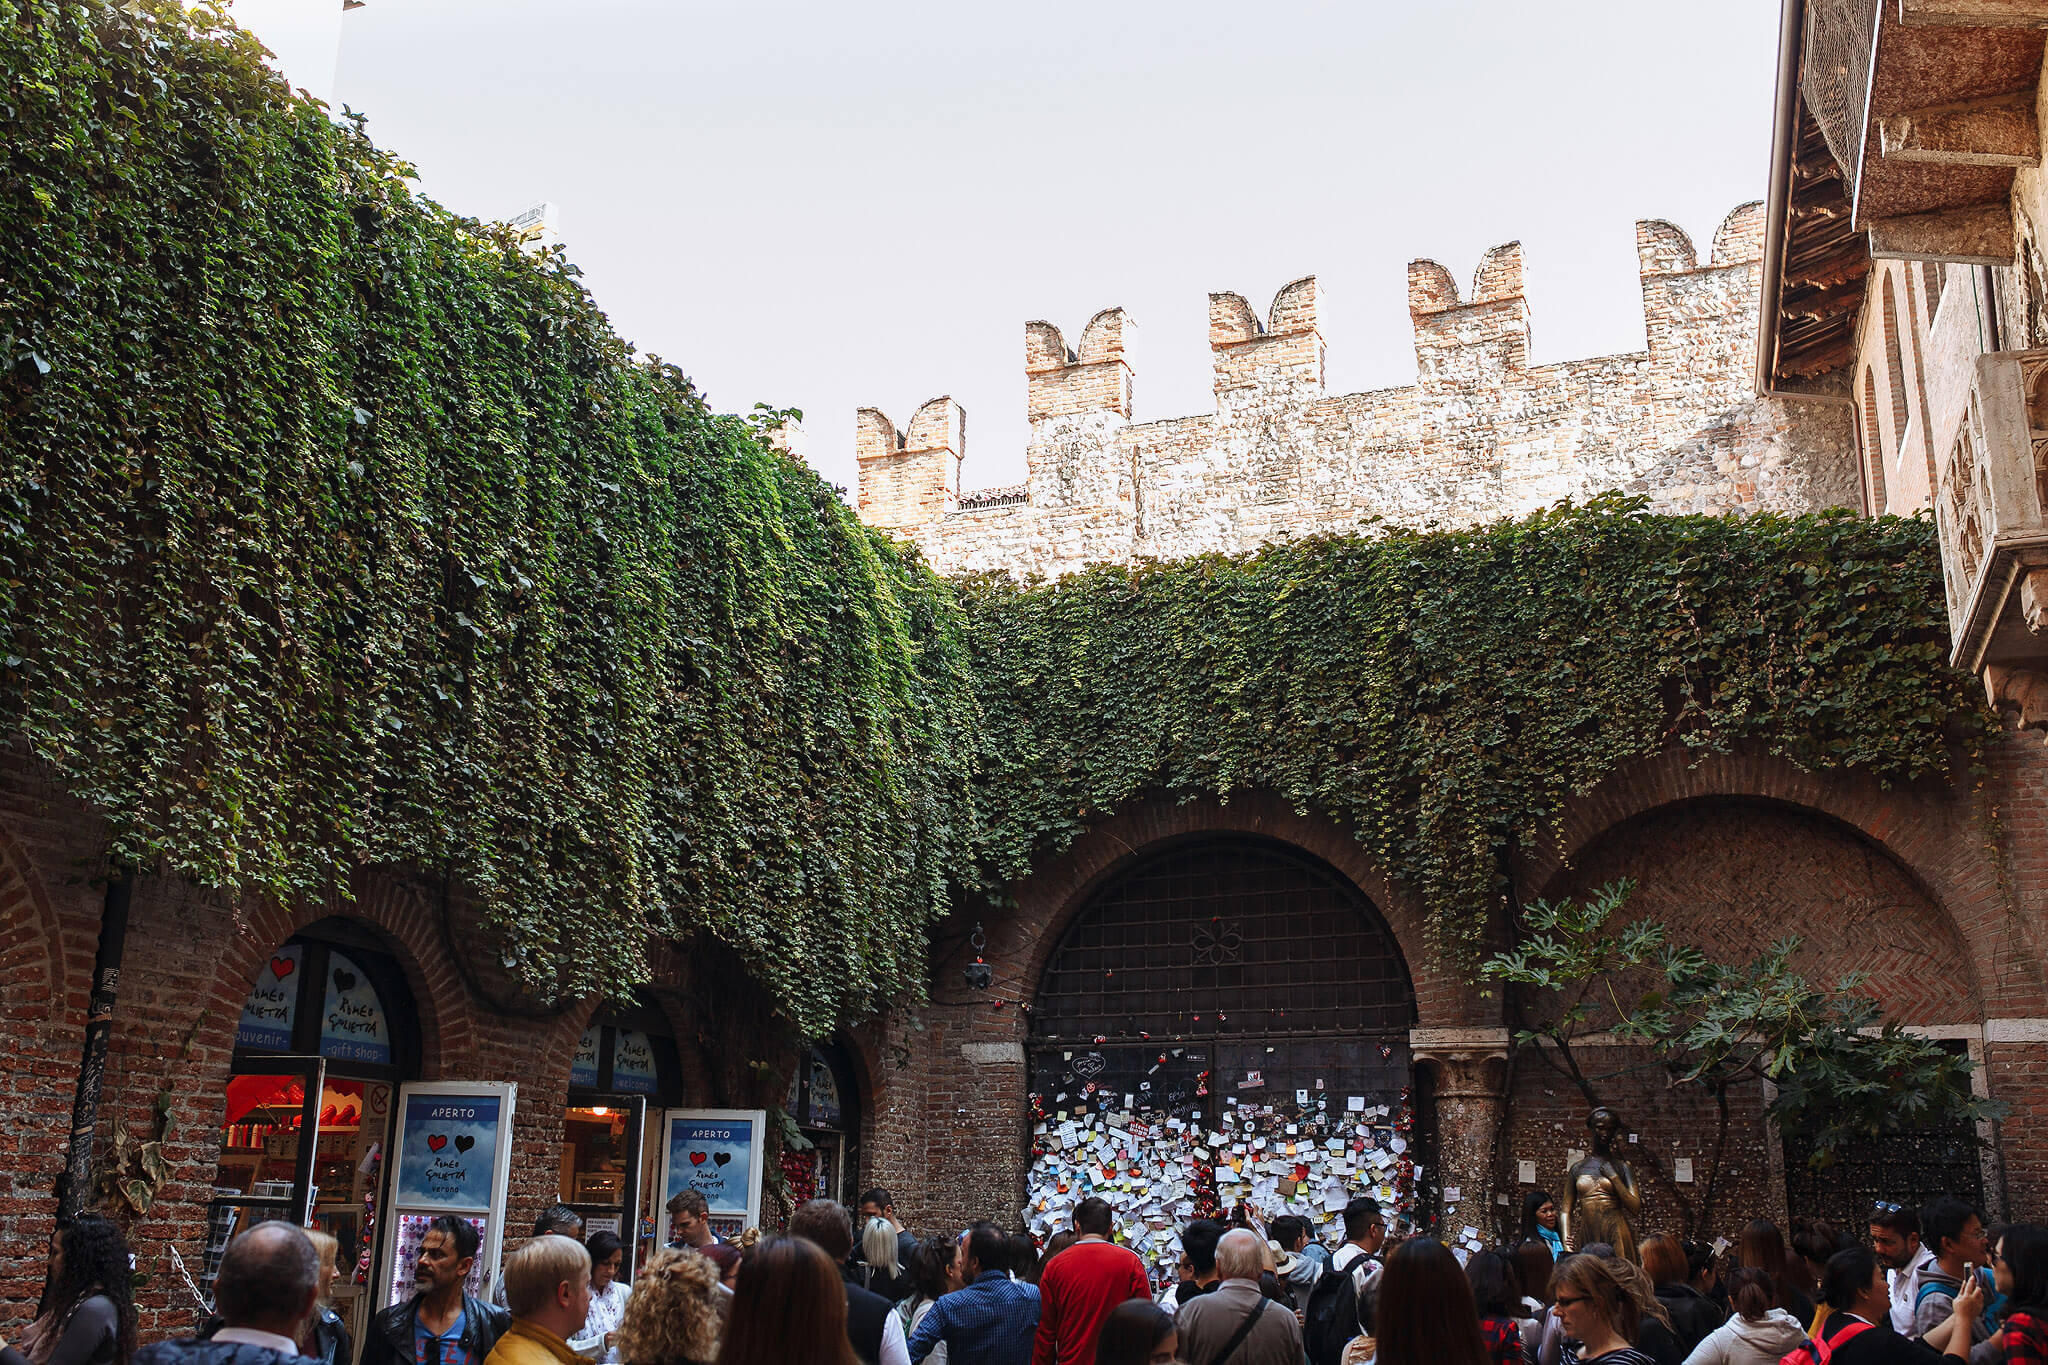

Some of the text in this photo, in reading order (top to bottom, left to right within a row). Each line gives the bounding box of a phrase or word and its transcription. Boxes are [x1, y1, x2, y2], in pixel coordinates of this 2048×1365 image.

[251, 988, 284, 1002] OMEO
[339, 997, 374, 1017] ROMEO
[236, 1031, 287, 1046] ouvenir-
[431, 1107, 475, 1118] APERTO
[691, 1129, 730, 1139] APERTO
[434, 1157, 460, 1168] ROMEO
[696, 1169, 719, 1179] ROMEO
